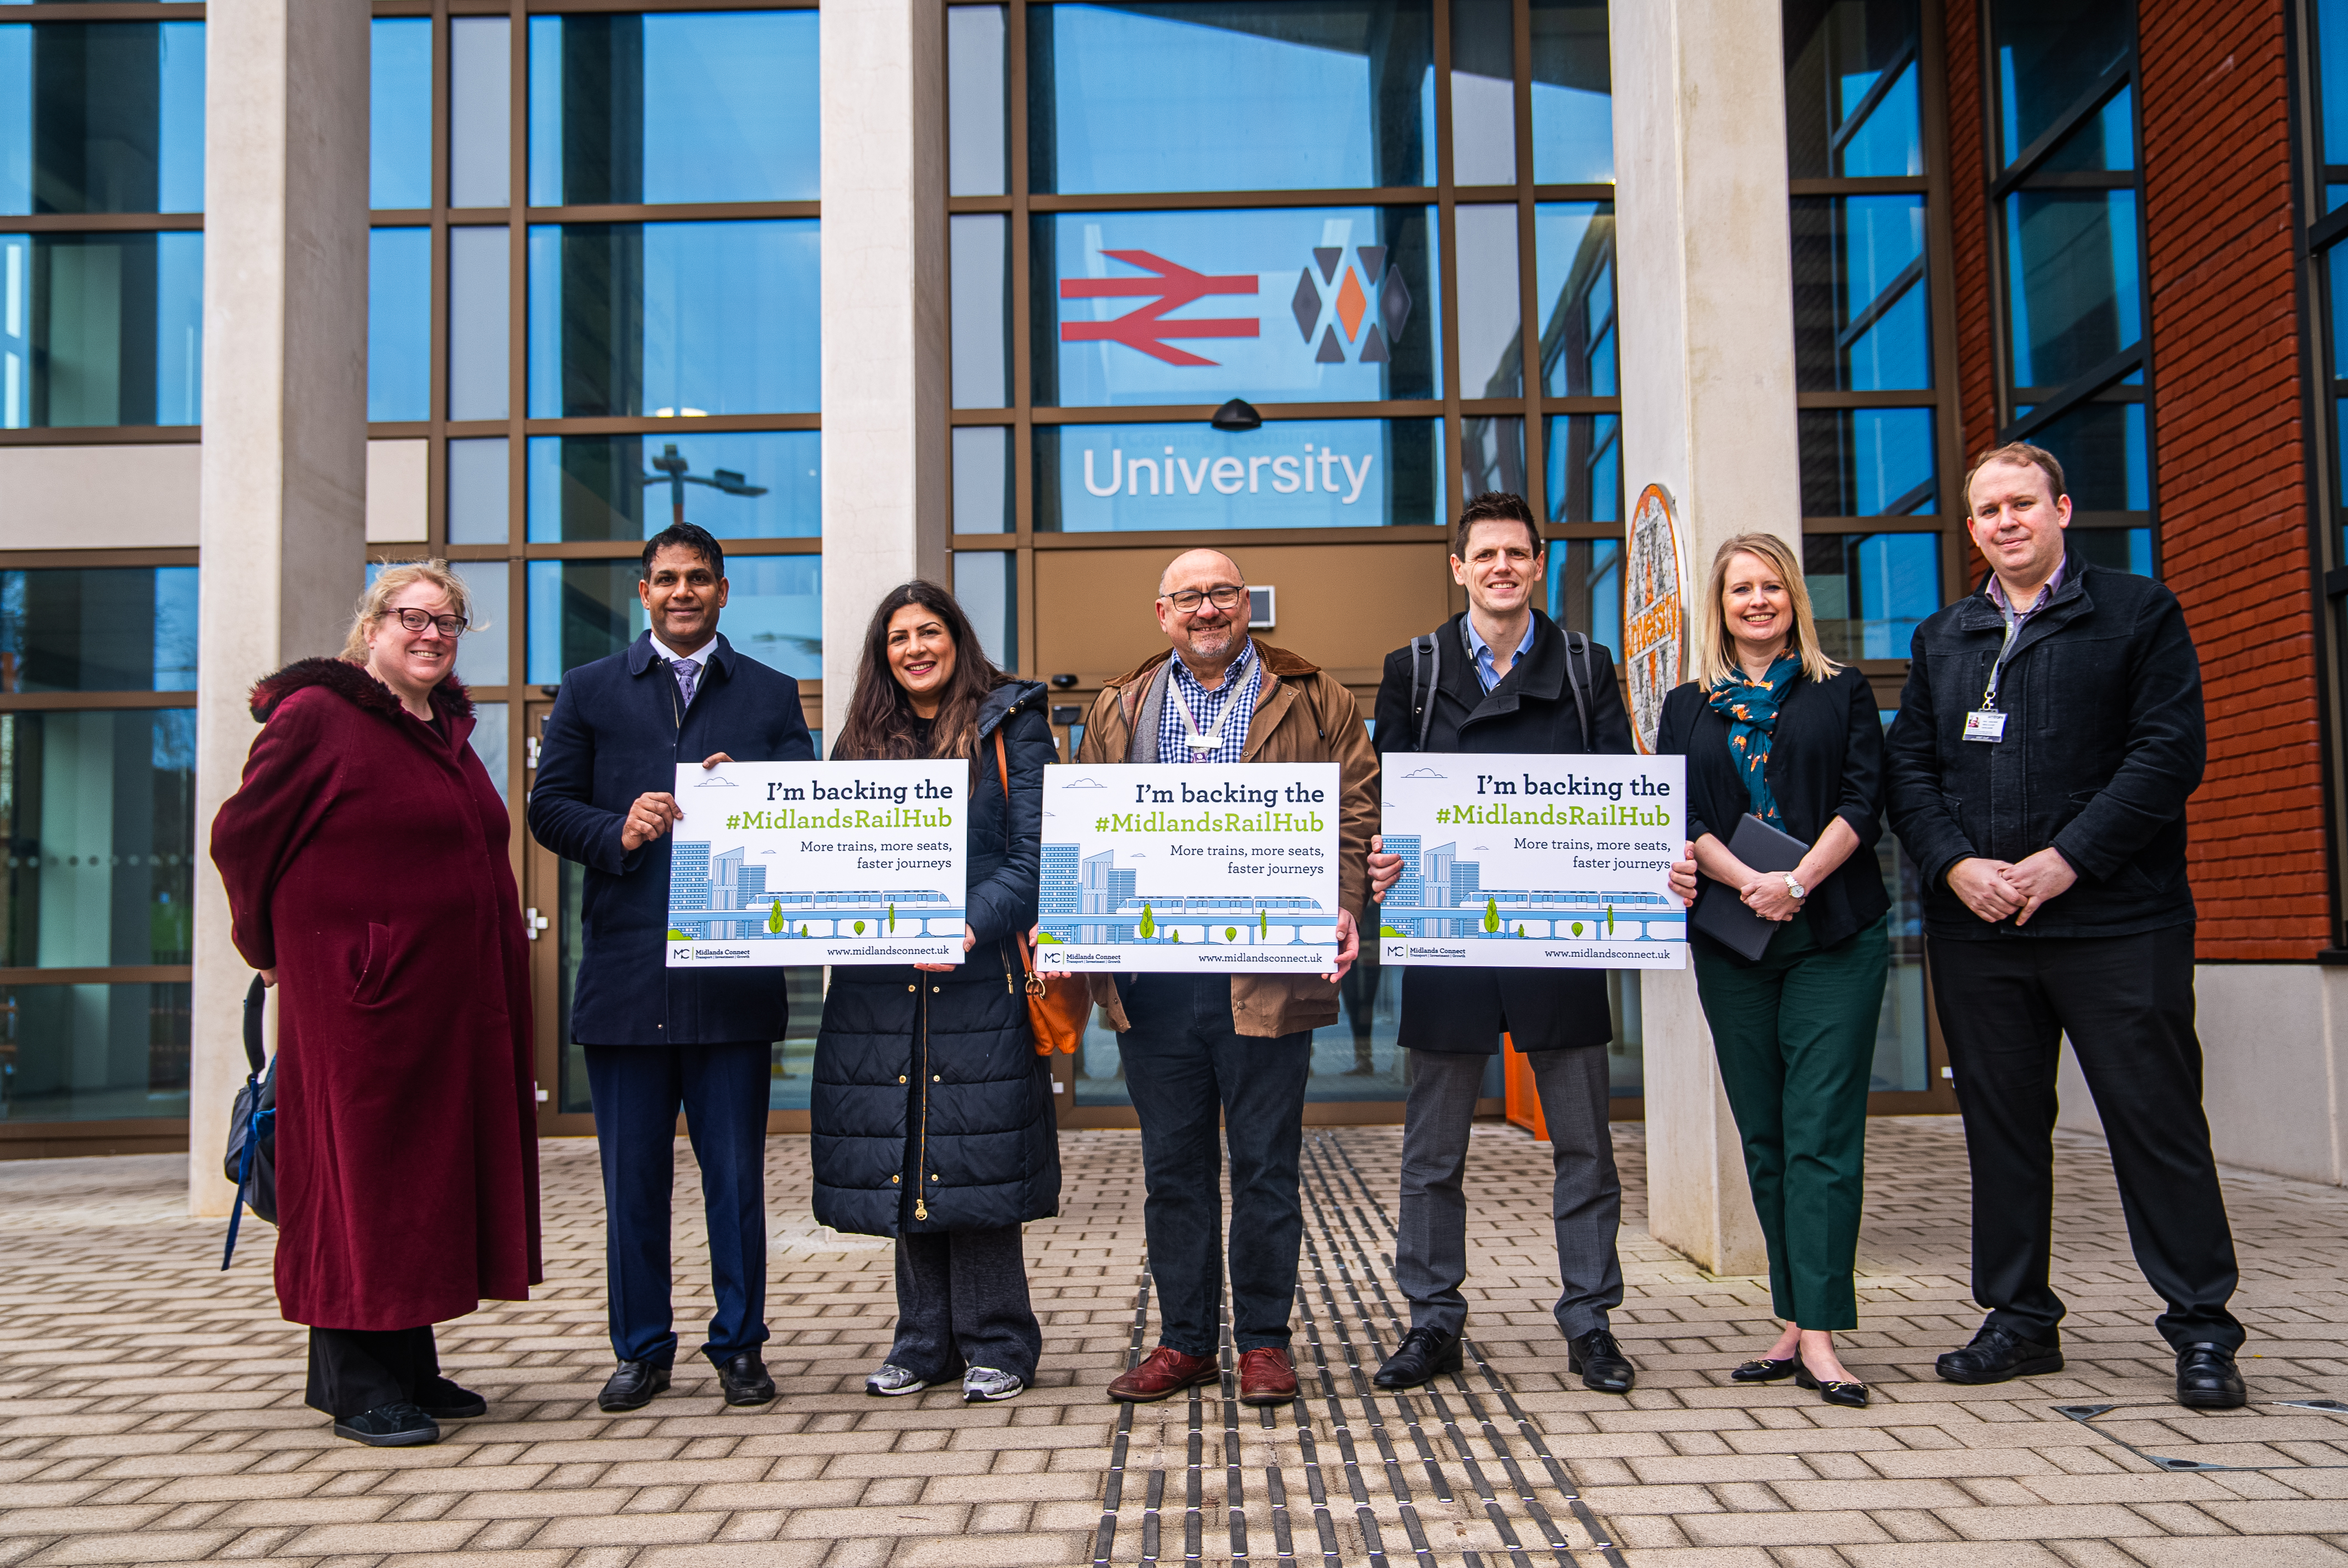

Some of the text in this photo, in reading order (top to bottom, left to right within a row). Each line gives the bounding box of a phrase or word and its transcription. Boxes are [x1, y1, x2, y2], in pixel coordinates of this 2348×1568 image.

[1083, 444, 1373, 504] University
[767, 779, 952, 804] I'm backing the
[1477, 773, 1670, 801] I'm backing the
[1136, 782, 1324, 807] I'm backing the
[727, 807, 951, 829] #MidlandsRailHub
[1436, 803, 1670, 826] #MidlandsRailHub
[1095, 812, 1323, 832] #MidlandsRailHub
[801, 842, 833, 852] More
[837, 841, 876, 853] trains,
[917, 842, 951, 852] seats,
[1171, 845, 1203, 855] More
[1207, 845, 1247, 857] trains,
[1289, 847, 1324, 857] seats,
[1514, 838, 1548, 849] More
[1552, 839, 1593, 851] trains,
[1635, 842, 1670, 852] seats,
[858, 857, 951, 870] faster journeys
[1228, 862, 1324, 876] faster journeys
[1573, 856, 1671, 870] faster journeys
[827, 945, 949, 955] www.midlandsconnect.uk
[1545, 948, 1670, 958] www.midlandsconnect.uk
[1199, 953, 1322, 962] www.midlandsconnect.uk
